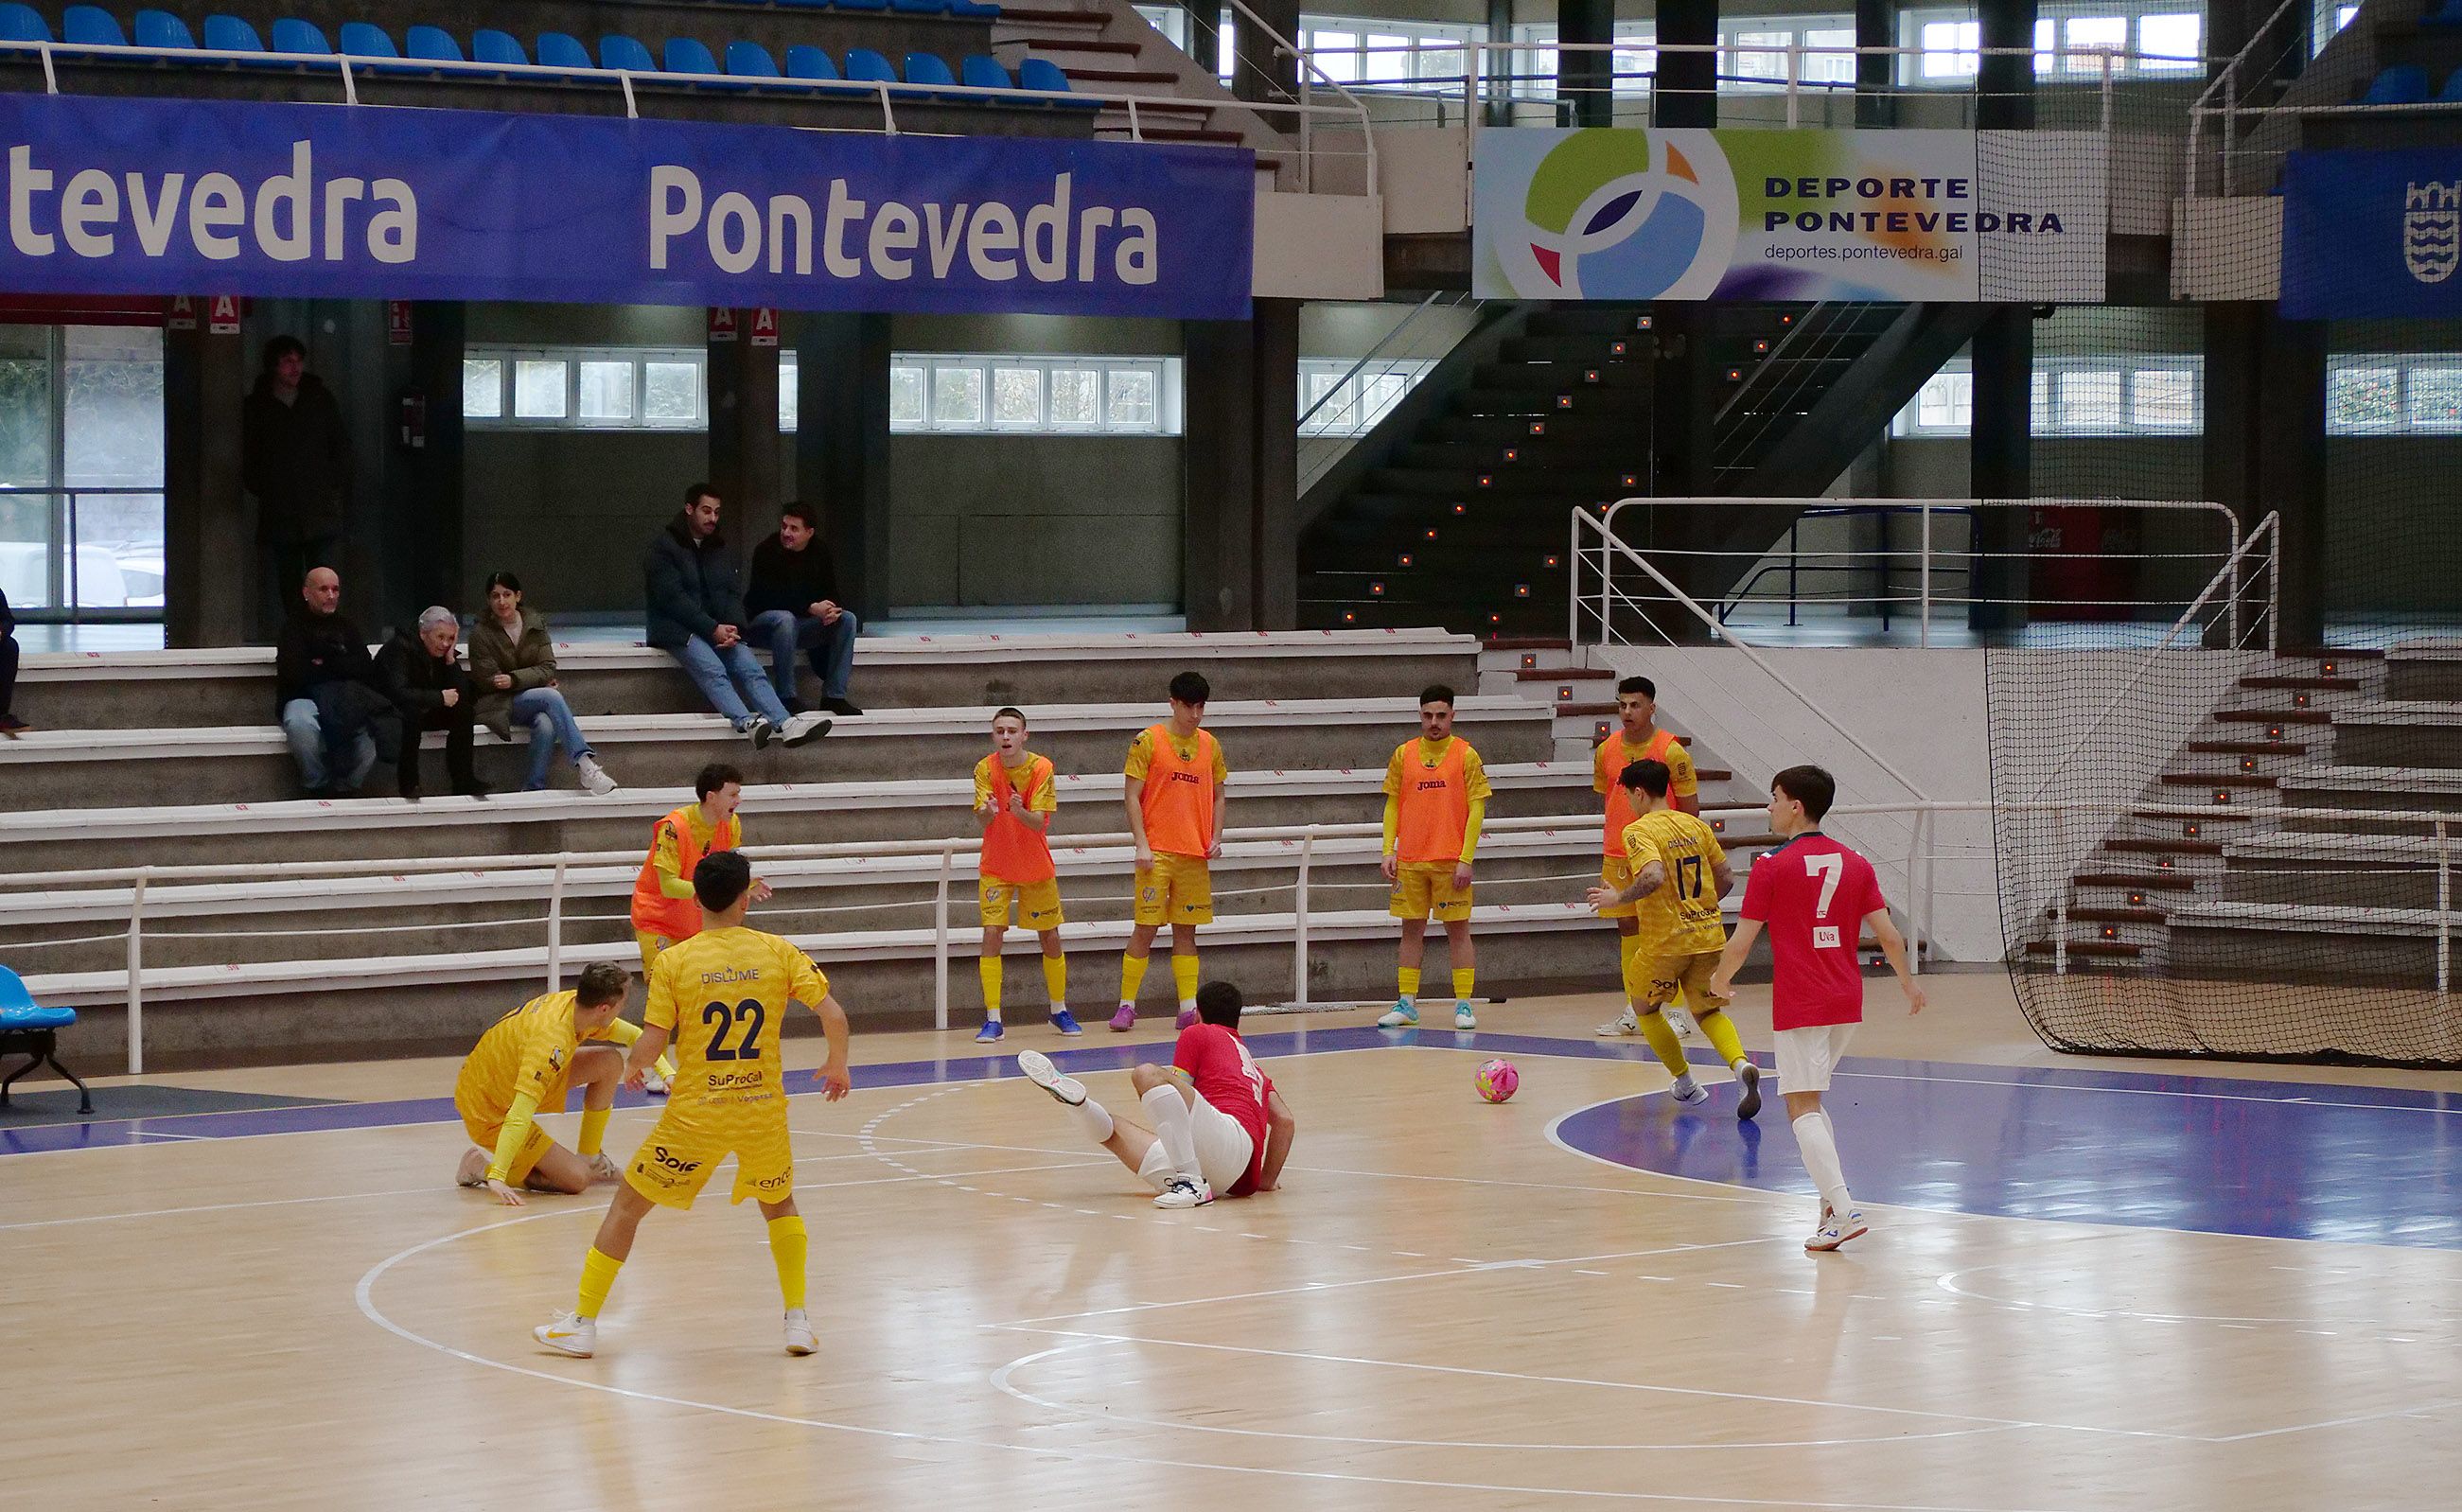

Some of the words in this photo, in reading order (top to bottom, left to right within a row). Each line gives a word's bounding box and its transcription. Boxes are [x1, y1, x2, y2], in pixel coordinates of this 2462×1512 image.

[1765, 177, 1969, 199] DEPORTE
[9, 140, 418, 264] tevedra
[649, 165, 1158, 286] Pontevedra
[1765, 211, 2064, 233] PONTEVEDRA
[1765, 243, 1963, 262] deportes.pontevedra.gal
[174, 295, 191, 313] A
[215, 295, 235, 318] A
[713, 308, 733, 325] A
[756, 308, 773, 330] A
[1171, 771, 1199, 784] Joma
[1417, 780, 1447, 791] Joma
[1676, 854, 1702, 901] 17
[1803, 853, 1843, 919] 7
[701, 968, 759, 985] DISLUME
[702, 998, 765, 1061] 22
